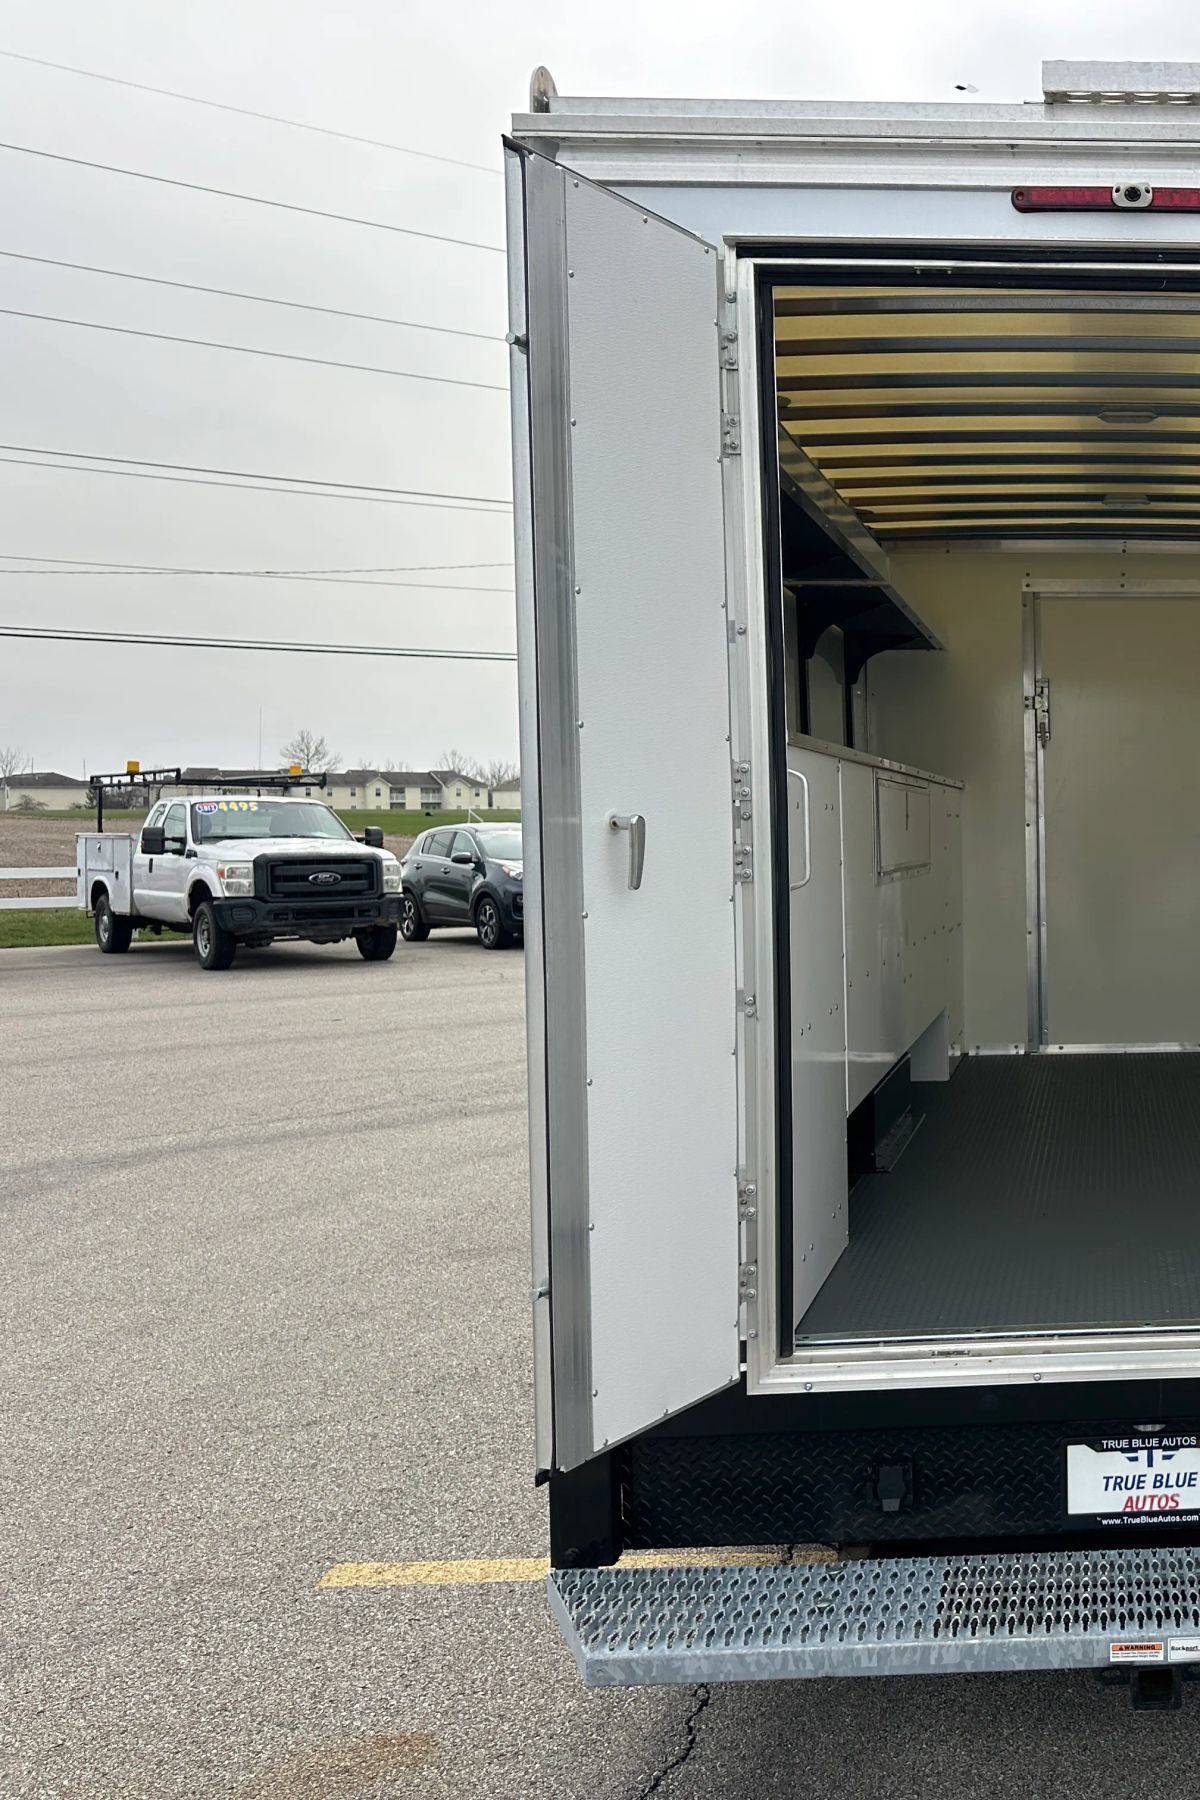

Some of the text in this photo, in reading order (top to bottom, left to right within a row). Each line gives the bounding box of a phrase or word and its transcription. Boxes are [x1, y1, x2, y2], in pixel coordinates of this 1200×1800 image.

[1102, 1436, 1197, 1449] TRUE BLUE AUTOS
[1103, 1472, 1198, 1492] TRUE BLUE
[1122, 1493, 1181, 1512] AUTOS
[1101, 1514, 1199, 1526] www.TrueBlueAutos.com
